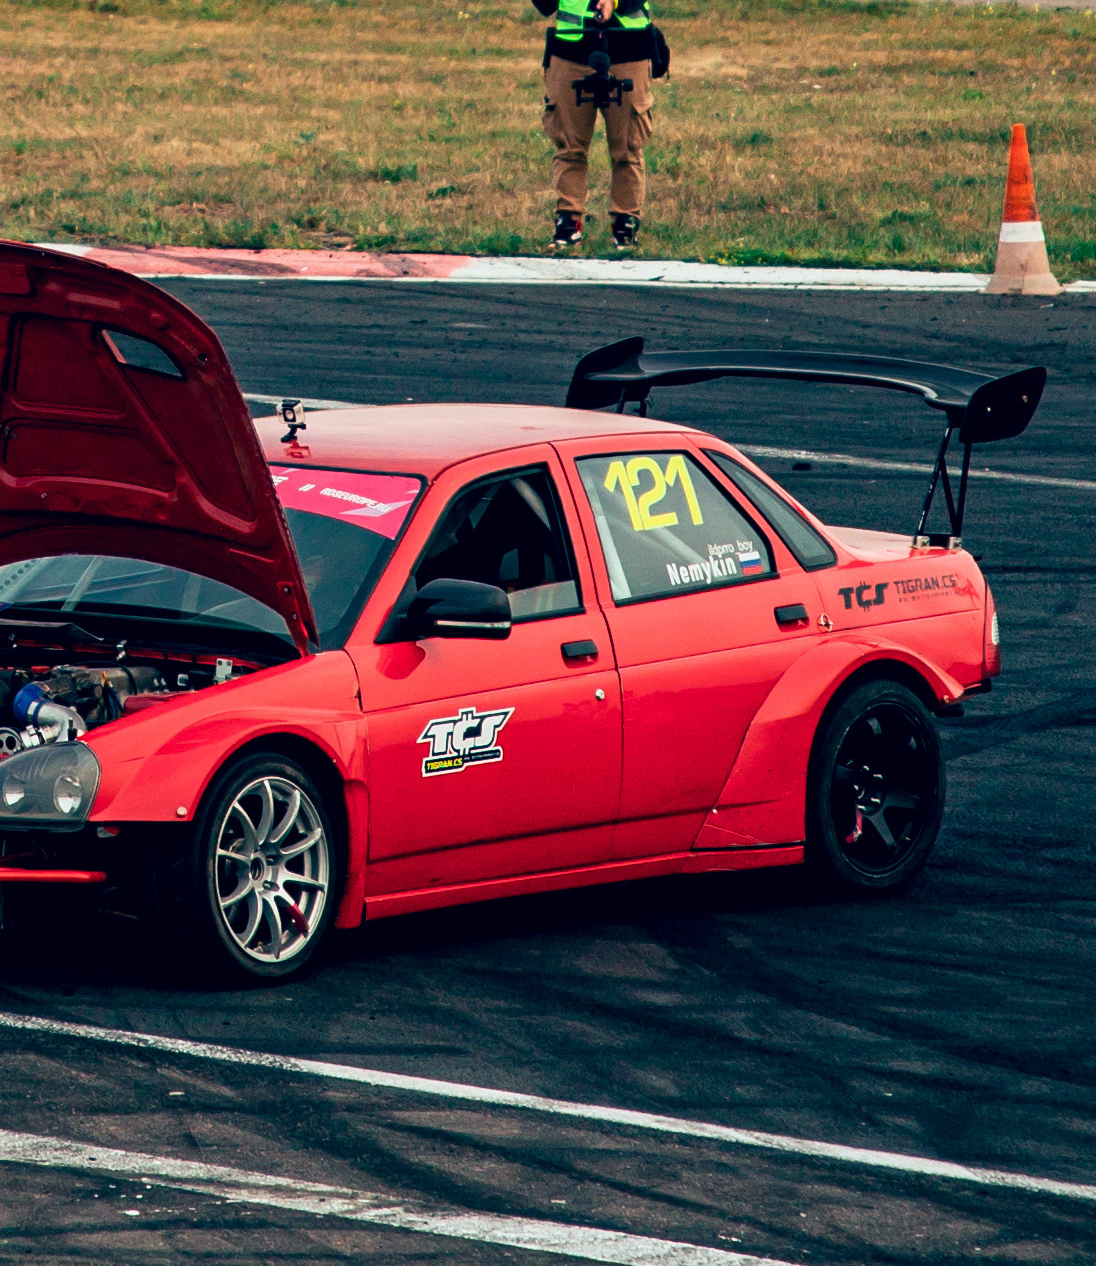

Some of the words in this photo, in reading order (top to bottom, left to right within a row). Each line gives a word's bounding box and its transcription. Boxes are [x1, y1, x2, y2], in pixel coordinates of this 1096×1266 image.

[604, 454, 704, 532] 121
[666, 554, 738, 586] Nemykin
[837, 580, 889, 611] TCS
[427, 713, 506, 756] TCS
